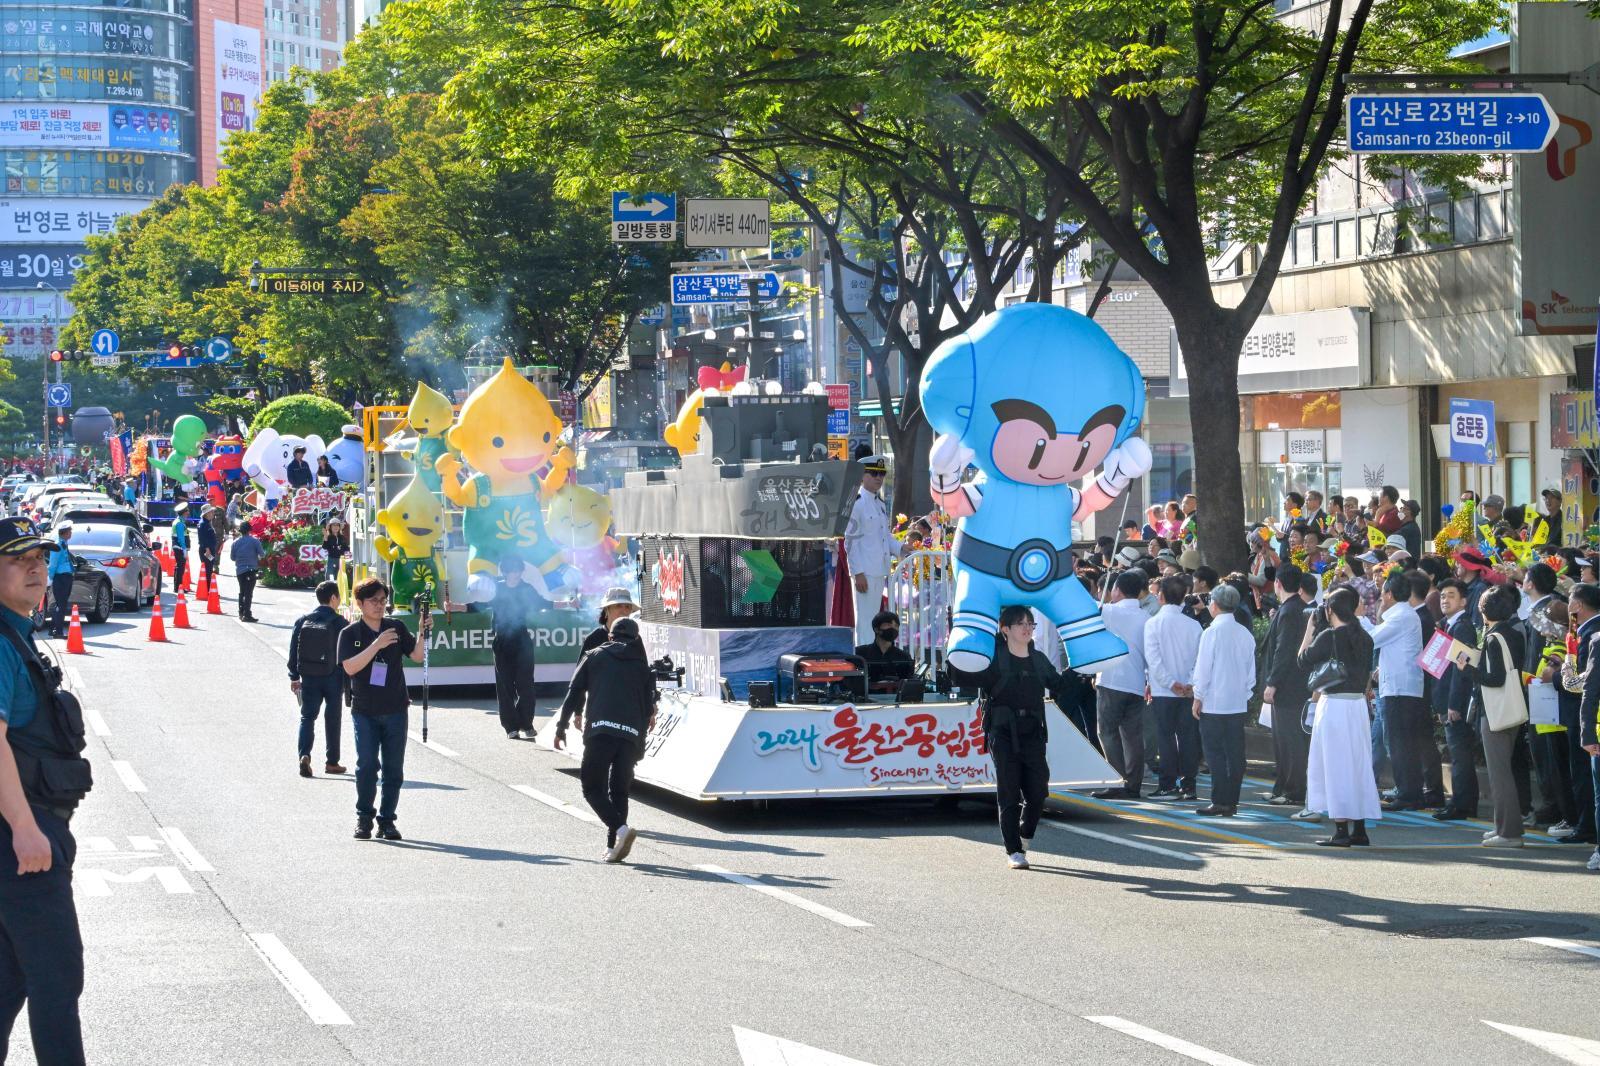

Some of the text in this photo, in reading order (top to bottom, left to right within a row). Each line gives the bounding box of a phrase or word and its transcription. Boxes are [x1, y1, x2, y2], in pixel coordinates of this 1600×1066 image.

[30, 109, 48, 119] 입주
[50, 109, 72, 119] 바로!
[226, 114, 241, 126] OPEN
[19, 120, 41, 131] 제로!
[82, 121, 102, 132] 제로!
[1355, 131, 1512, 148] Samsan-ro 23beon-gil
[14, 211, 72, 234] 번영로
[617, 222, 673, 240] 일방통행
[690, 212, 767, 235] 여기서부터 440m
[273, 279, 324, 293] 이동하여
[1541, 303, 1557, 314] SK
[1261, 331, 1296, 358] 분양홍보관
[1456, 415, 1484, 439] 효문동
[783, 490, 821, 520] 995
[757, 724, 821, 766] 2024
[870, 766, 929, 782] Since1967
